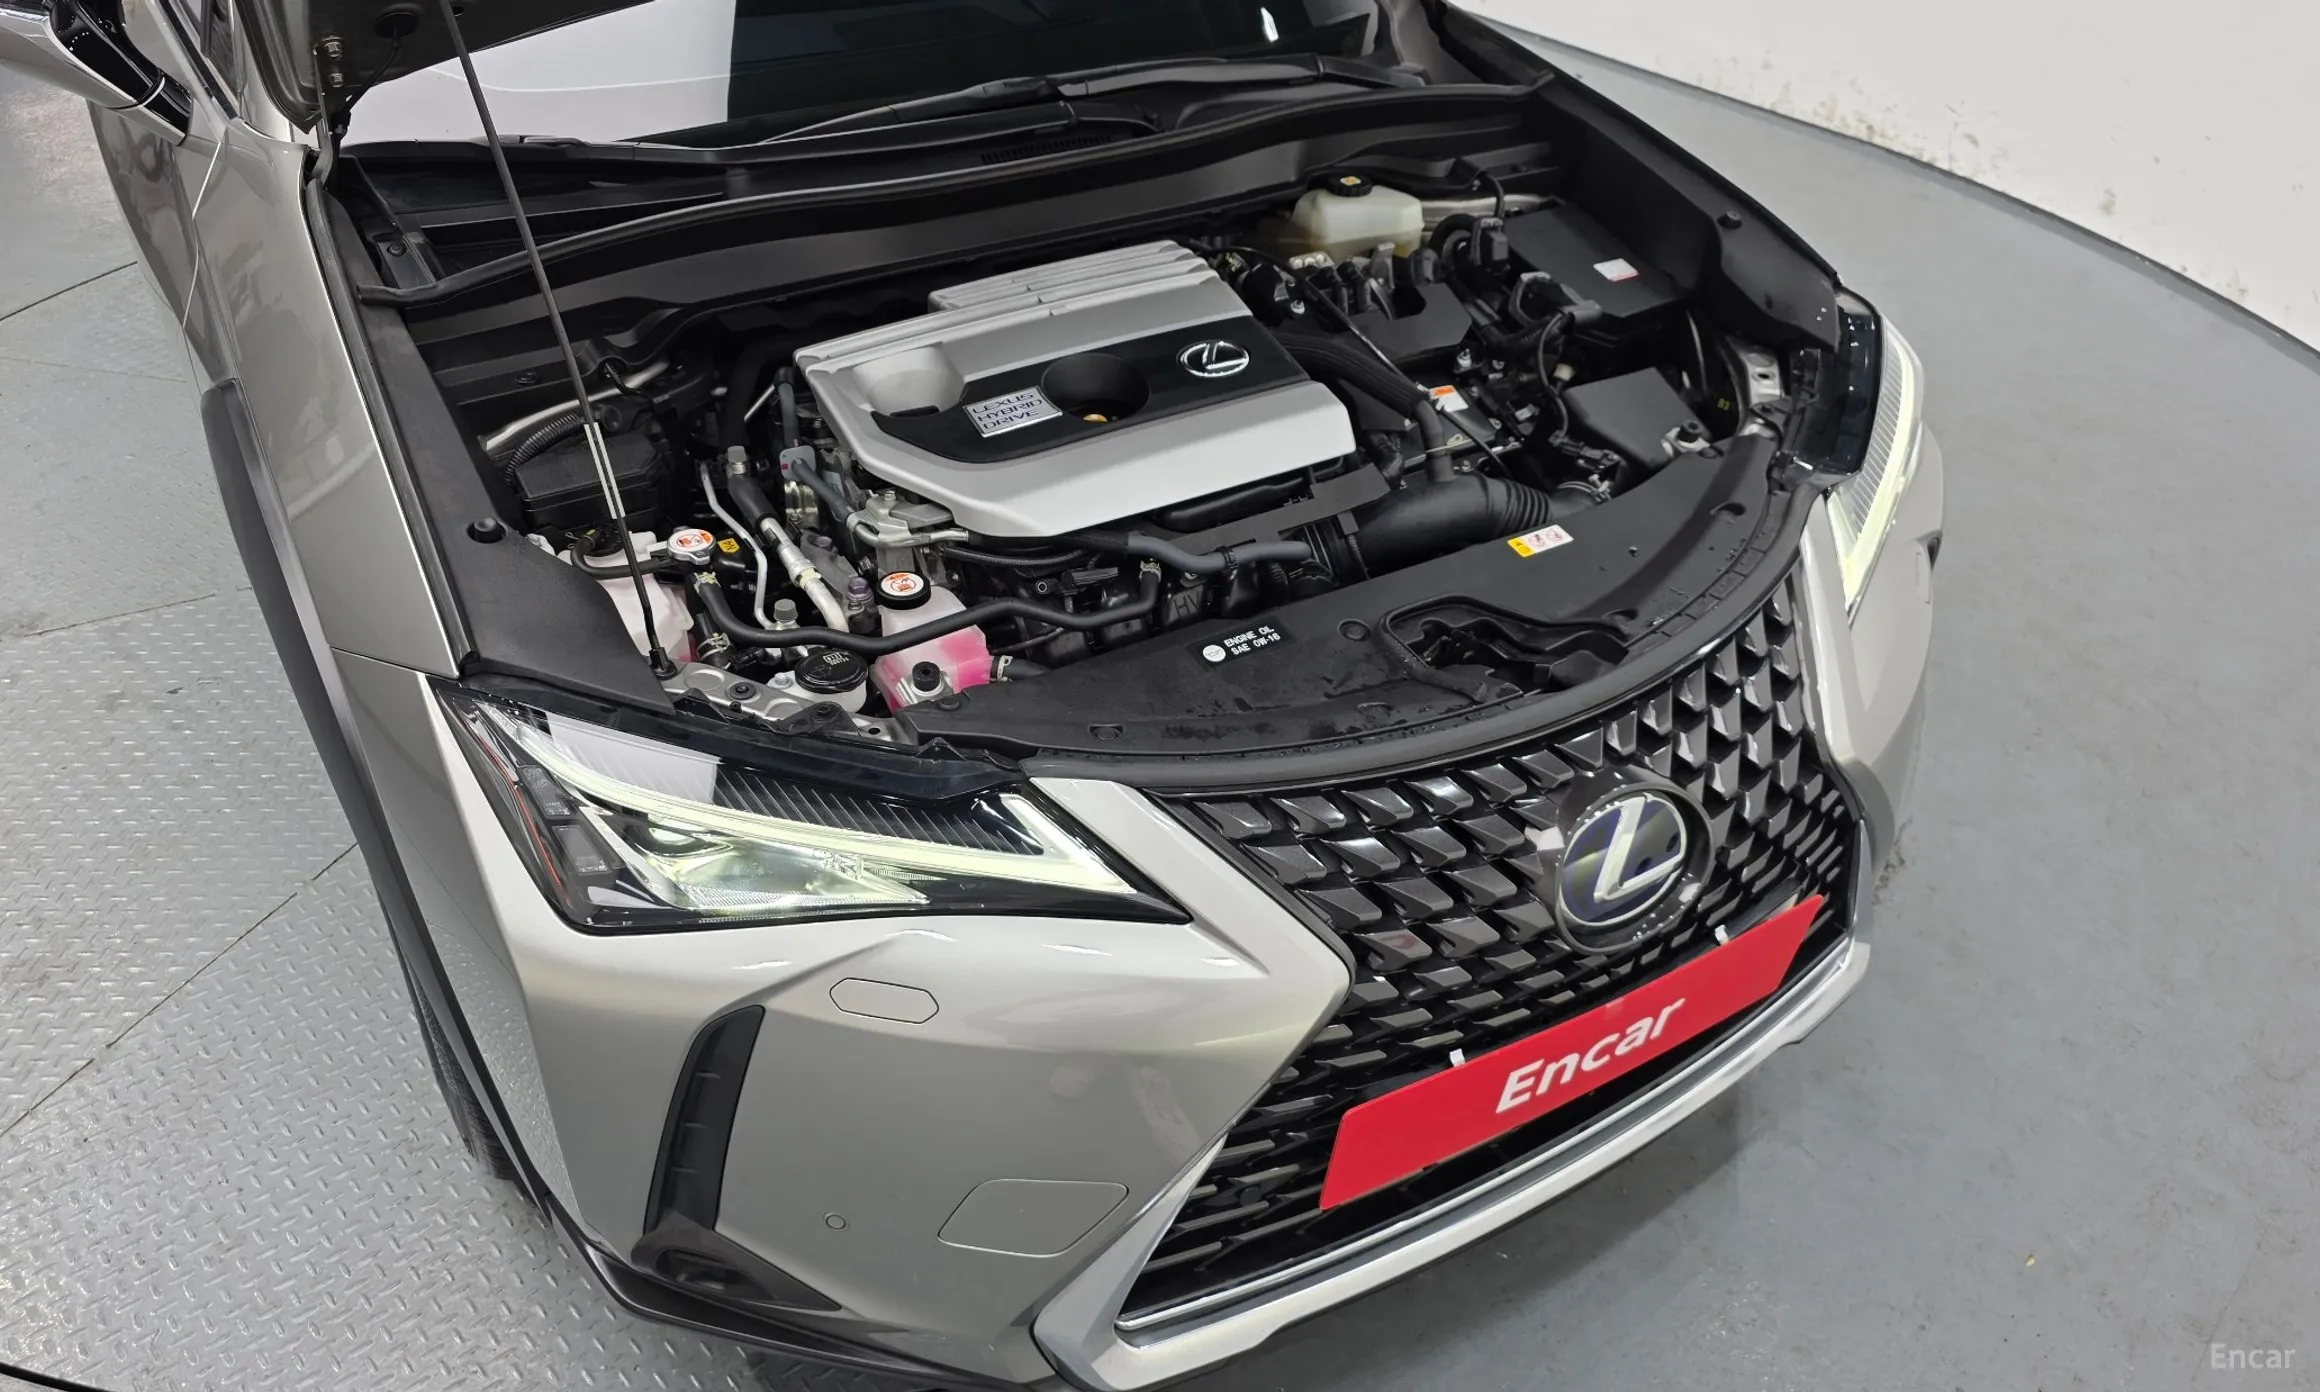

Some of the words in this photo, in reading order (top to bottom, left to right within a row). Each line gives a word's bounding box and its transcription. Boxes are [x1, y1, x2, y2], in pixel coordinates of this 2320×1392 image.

[972, 392, 1034, 414] LEXUS
[977, 400, 1043, 422] HYBRID
[983, 409, 1040, 430] DRIVE
[1223, 630, 1257, 648] ENGINE
[1258, 625, 1275, 635] OIL
[1230, 643, 1251, 656] SAE
[1495, 997, 1686, 1114] Encar
